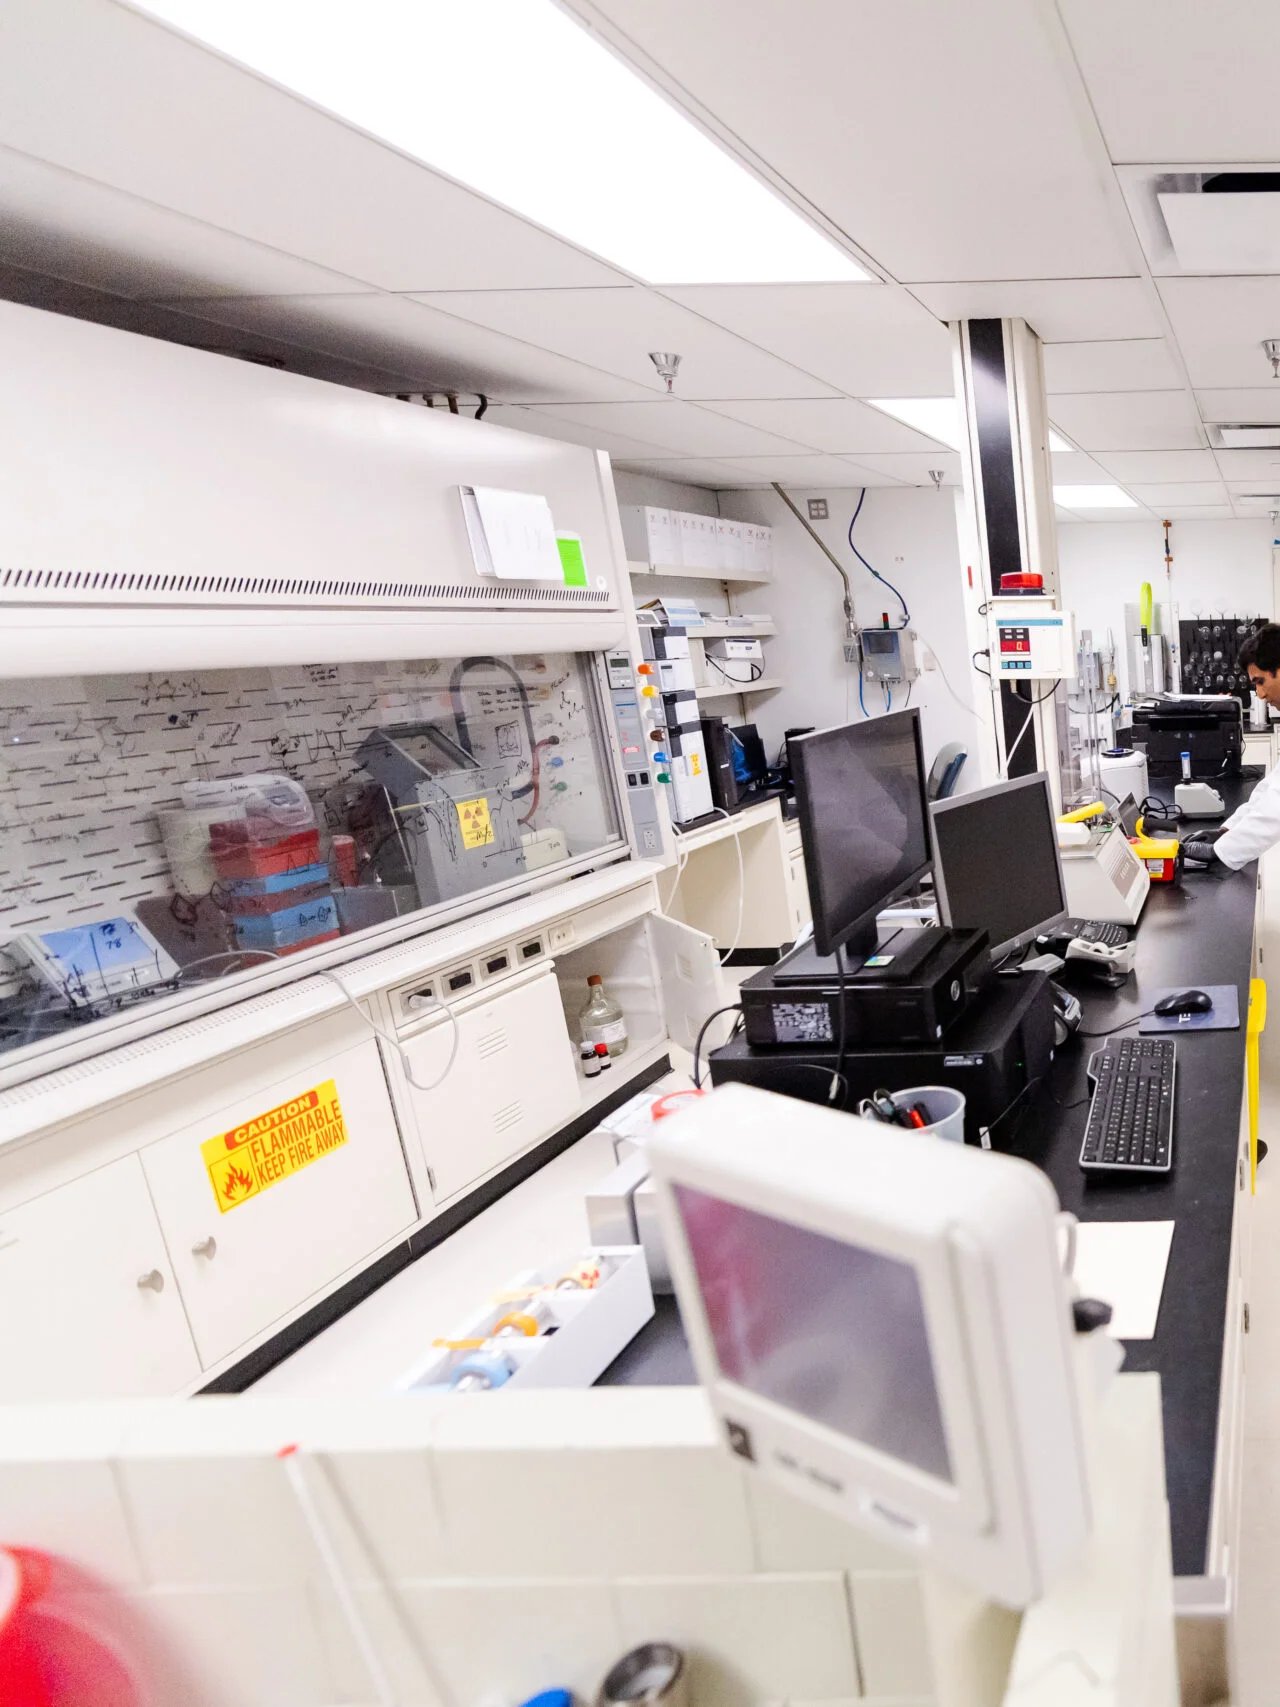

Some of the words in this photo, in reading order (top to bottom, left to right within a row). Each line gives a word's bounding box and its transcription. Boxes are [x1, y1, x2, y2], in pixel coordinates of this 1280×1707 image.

[233, 1094, 312, 1144] CAUTION
[250, 1099, 342, 1163] FLAMMABLE
[256, 1153, 286, 1186] KEEP
[288, 1137, 315, 1169] FIRE
[315, 1119, 346, 1155] AWAY
